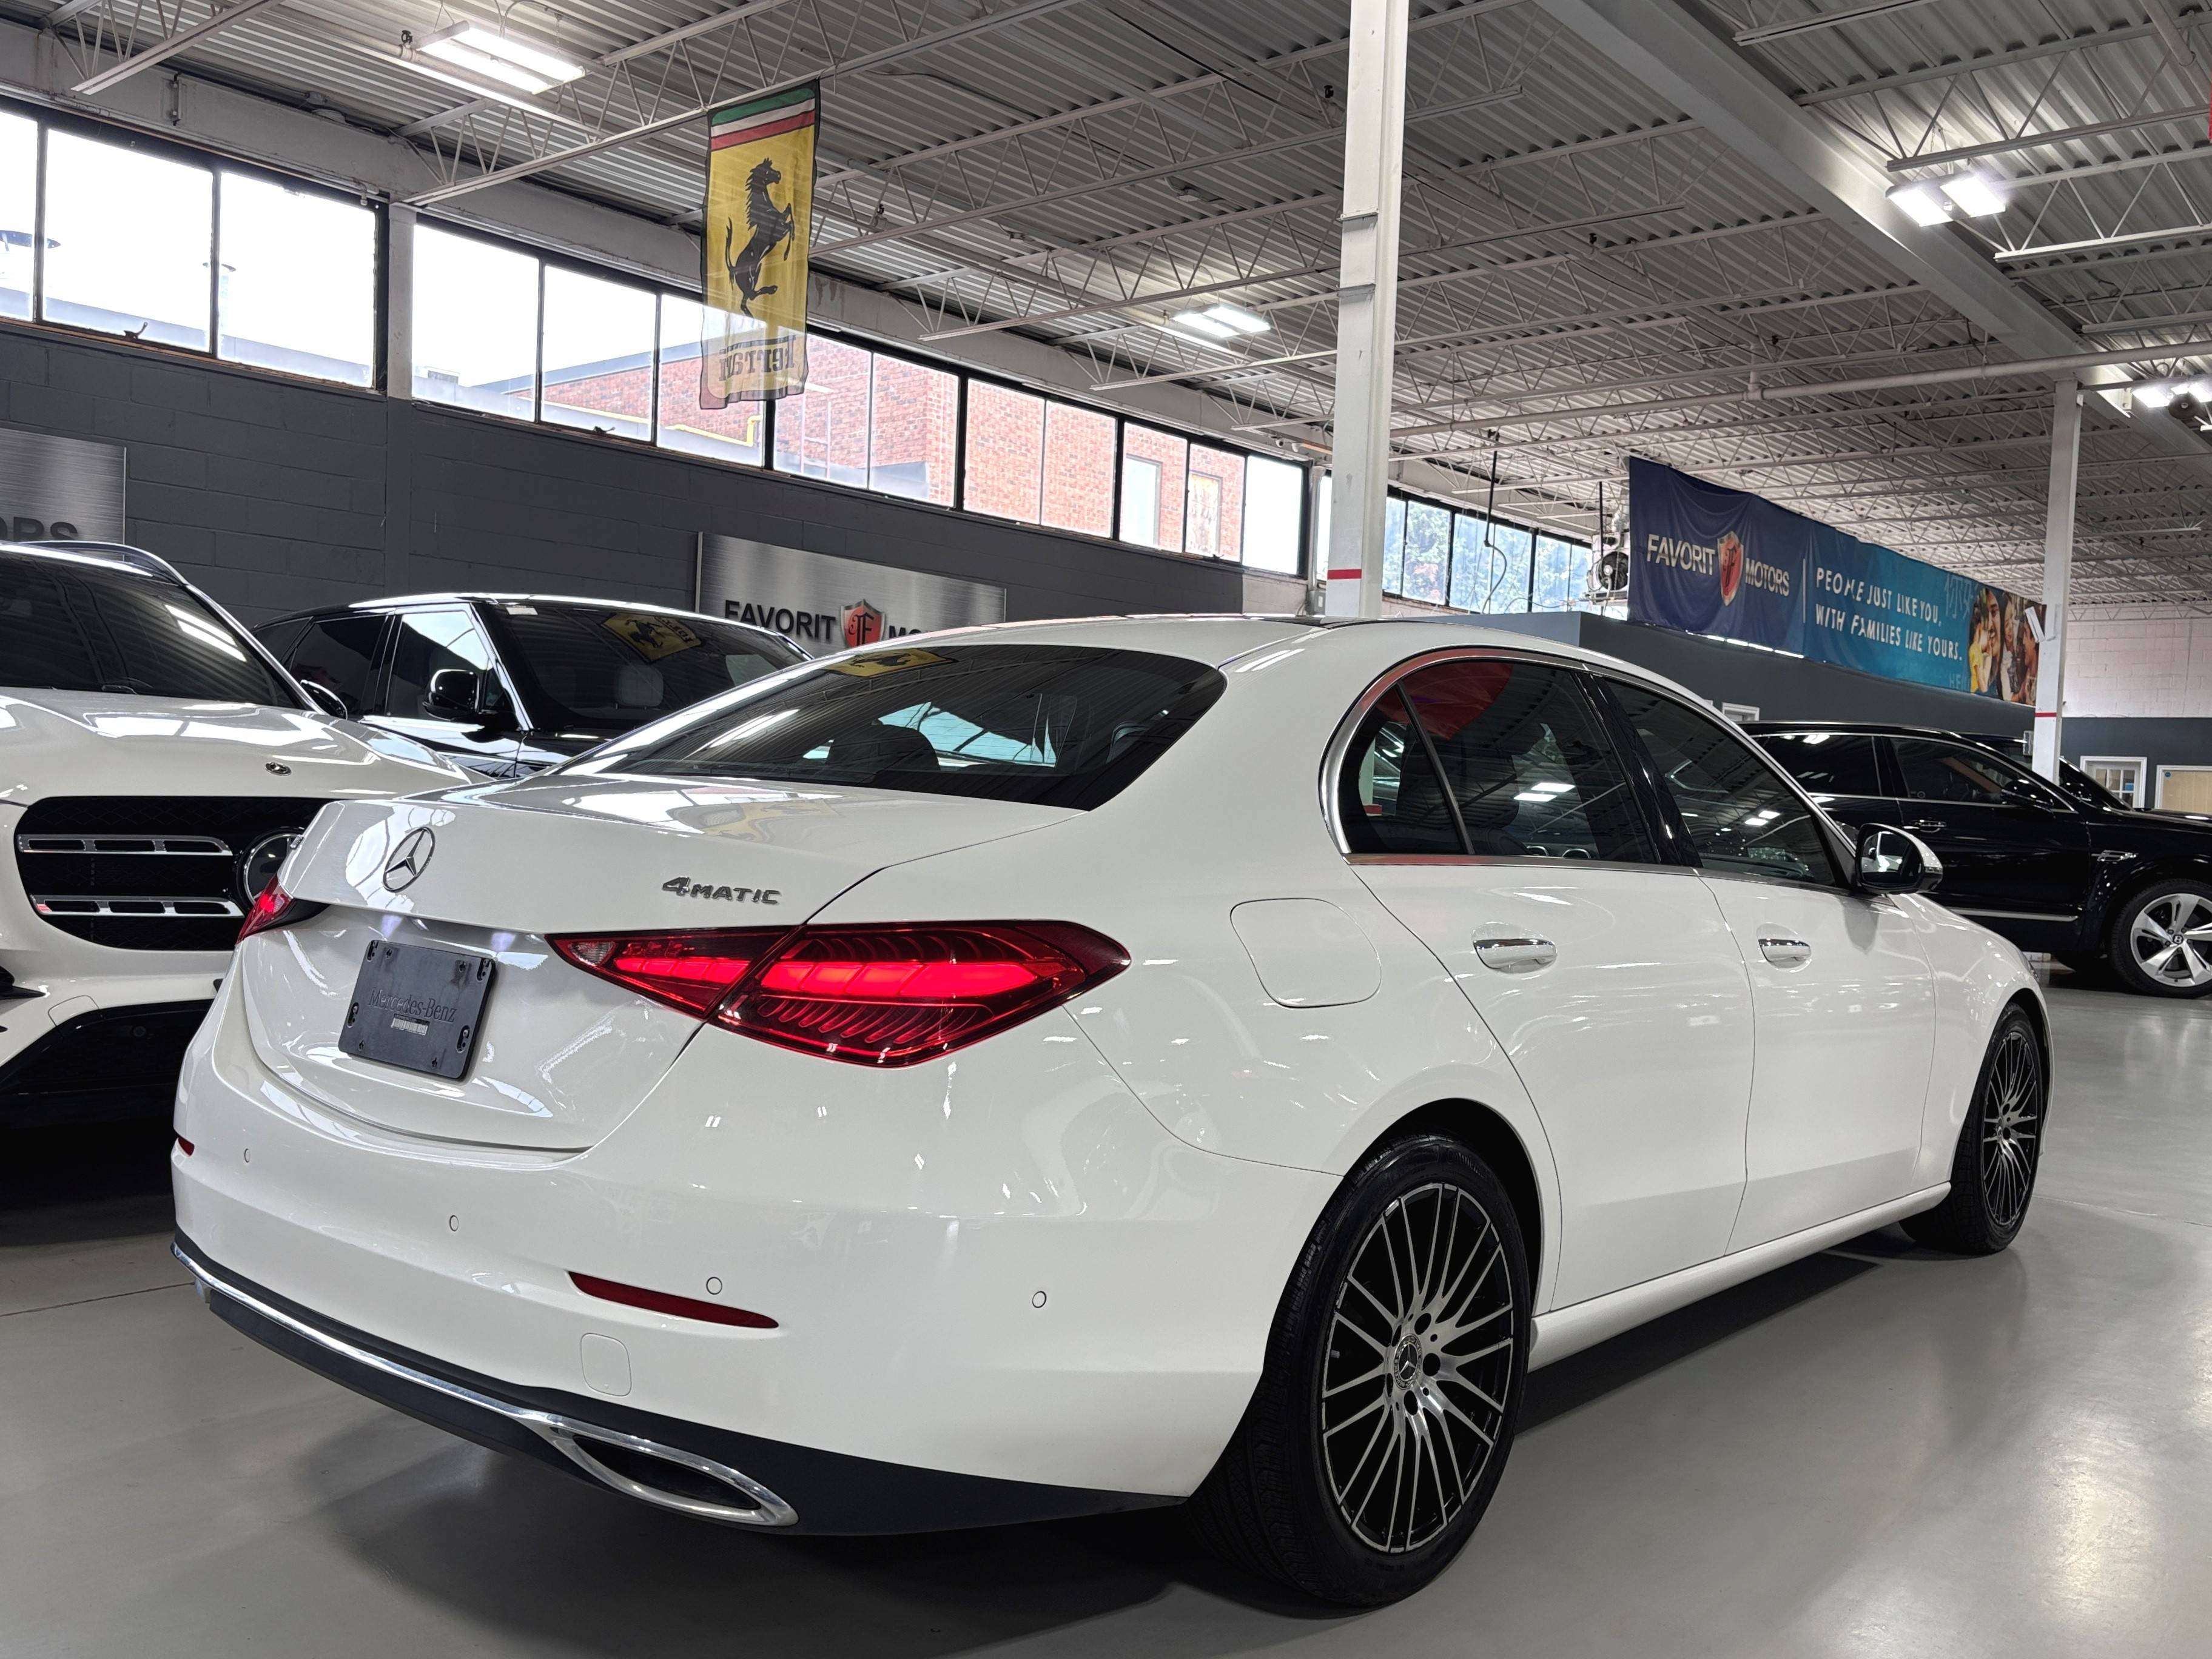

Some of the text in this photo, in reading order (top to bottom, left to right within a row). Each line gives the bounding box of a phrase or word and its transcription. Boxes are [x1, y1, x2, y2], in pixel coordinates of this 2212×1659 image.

[1647, 534, 1716, 575] FAVORIT
[1745, 558, 1790, 597] MOTORS
[724, 600, 836, 641] FAVORIT
[1866, 585, 1892, 610] JUST
[1897, 593, 1918, 617] LIKE
[1920, 600, 1941, 627] YOU,
[1815, 604, 1963, 661] WITH FAMILIES LIKE YOURS.
[662, 876, 781, 905] 4MATIC
[367, 988, 458, 1024] Mercedes-Benz
